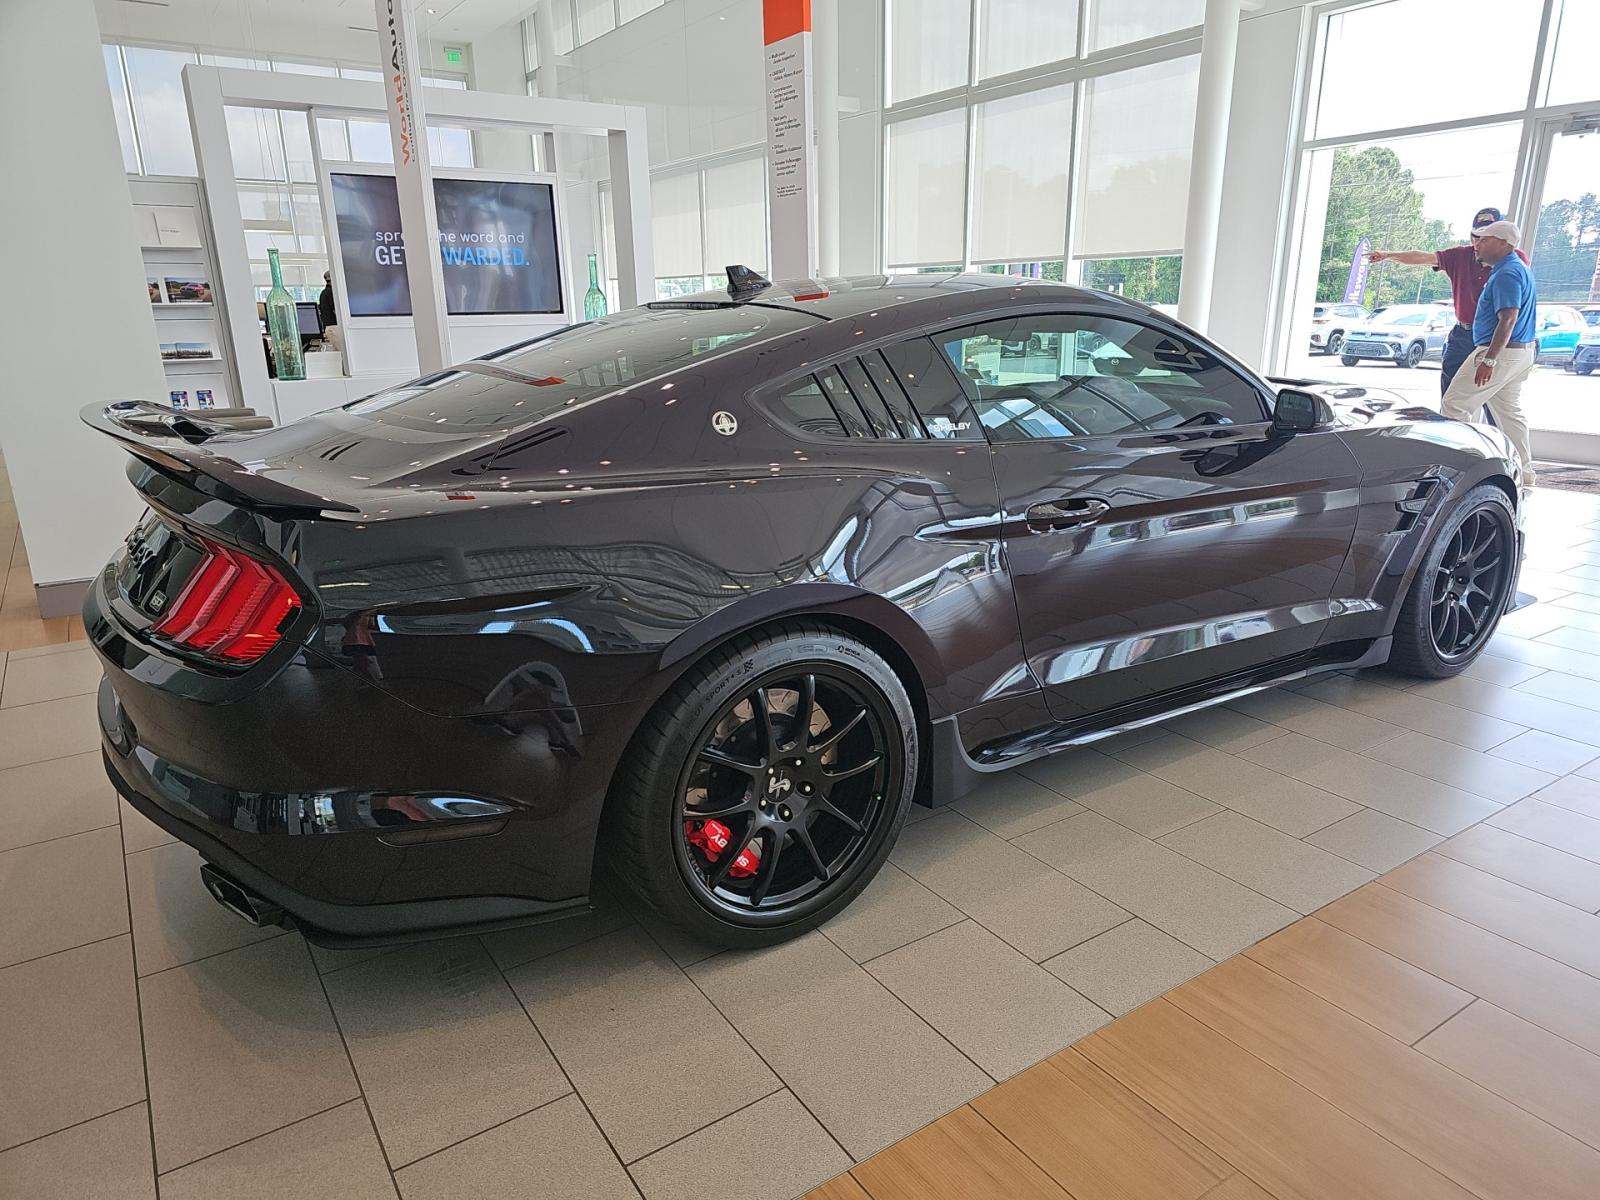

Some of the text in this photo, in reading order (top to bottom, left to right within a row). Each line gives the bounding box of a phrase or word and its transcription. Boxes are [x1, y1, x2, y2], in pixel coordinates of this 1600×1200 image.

[375, 229, 525, 245] spr he word and
[441, 246, 530, 266] WARDED.
[933, 422, 971, 431] SHELBY
